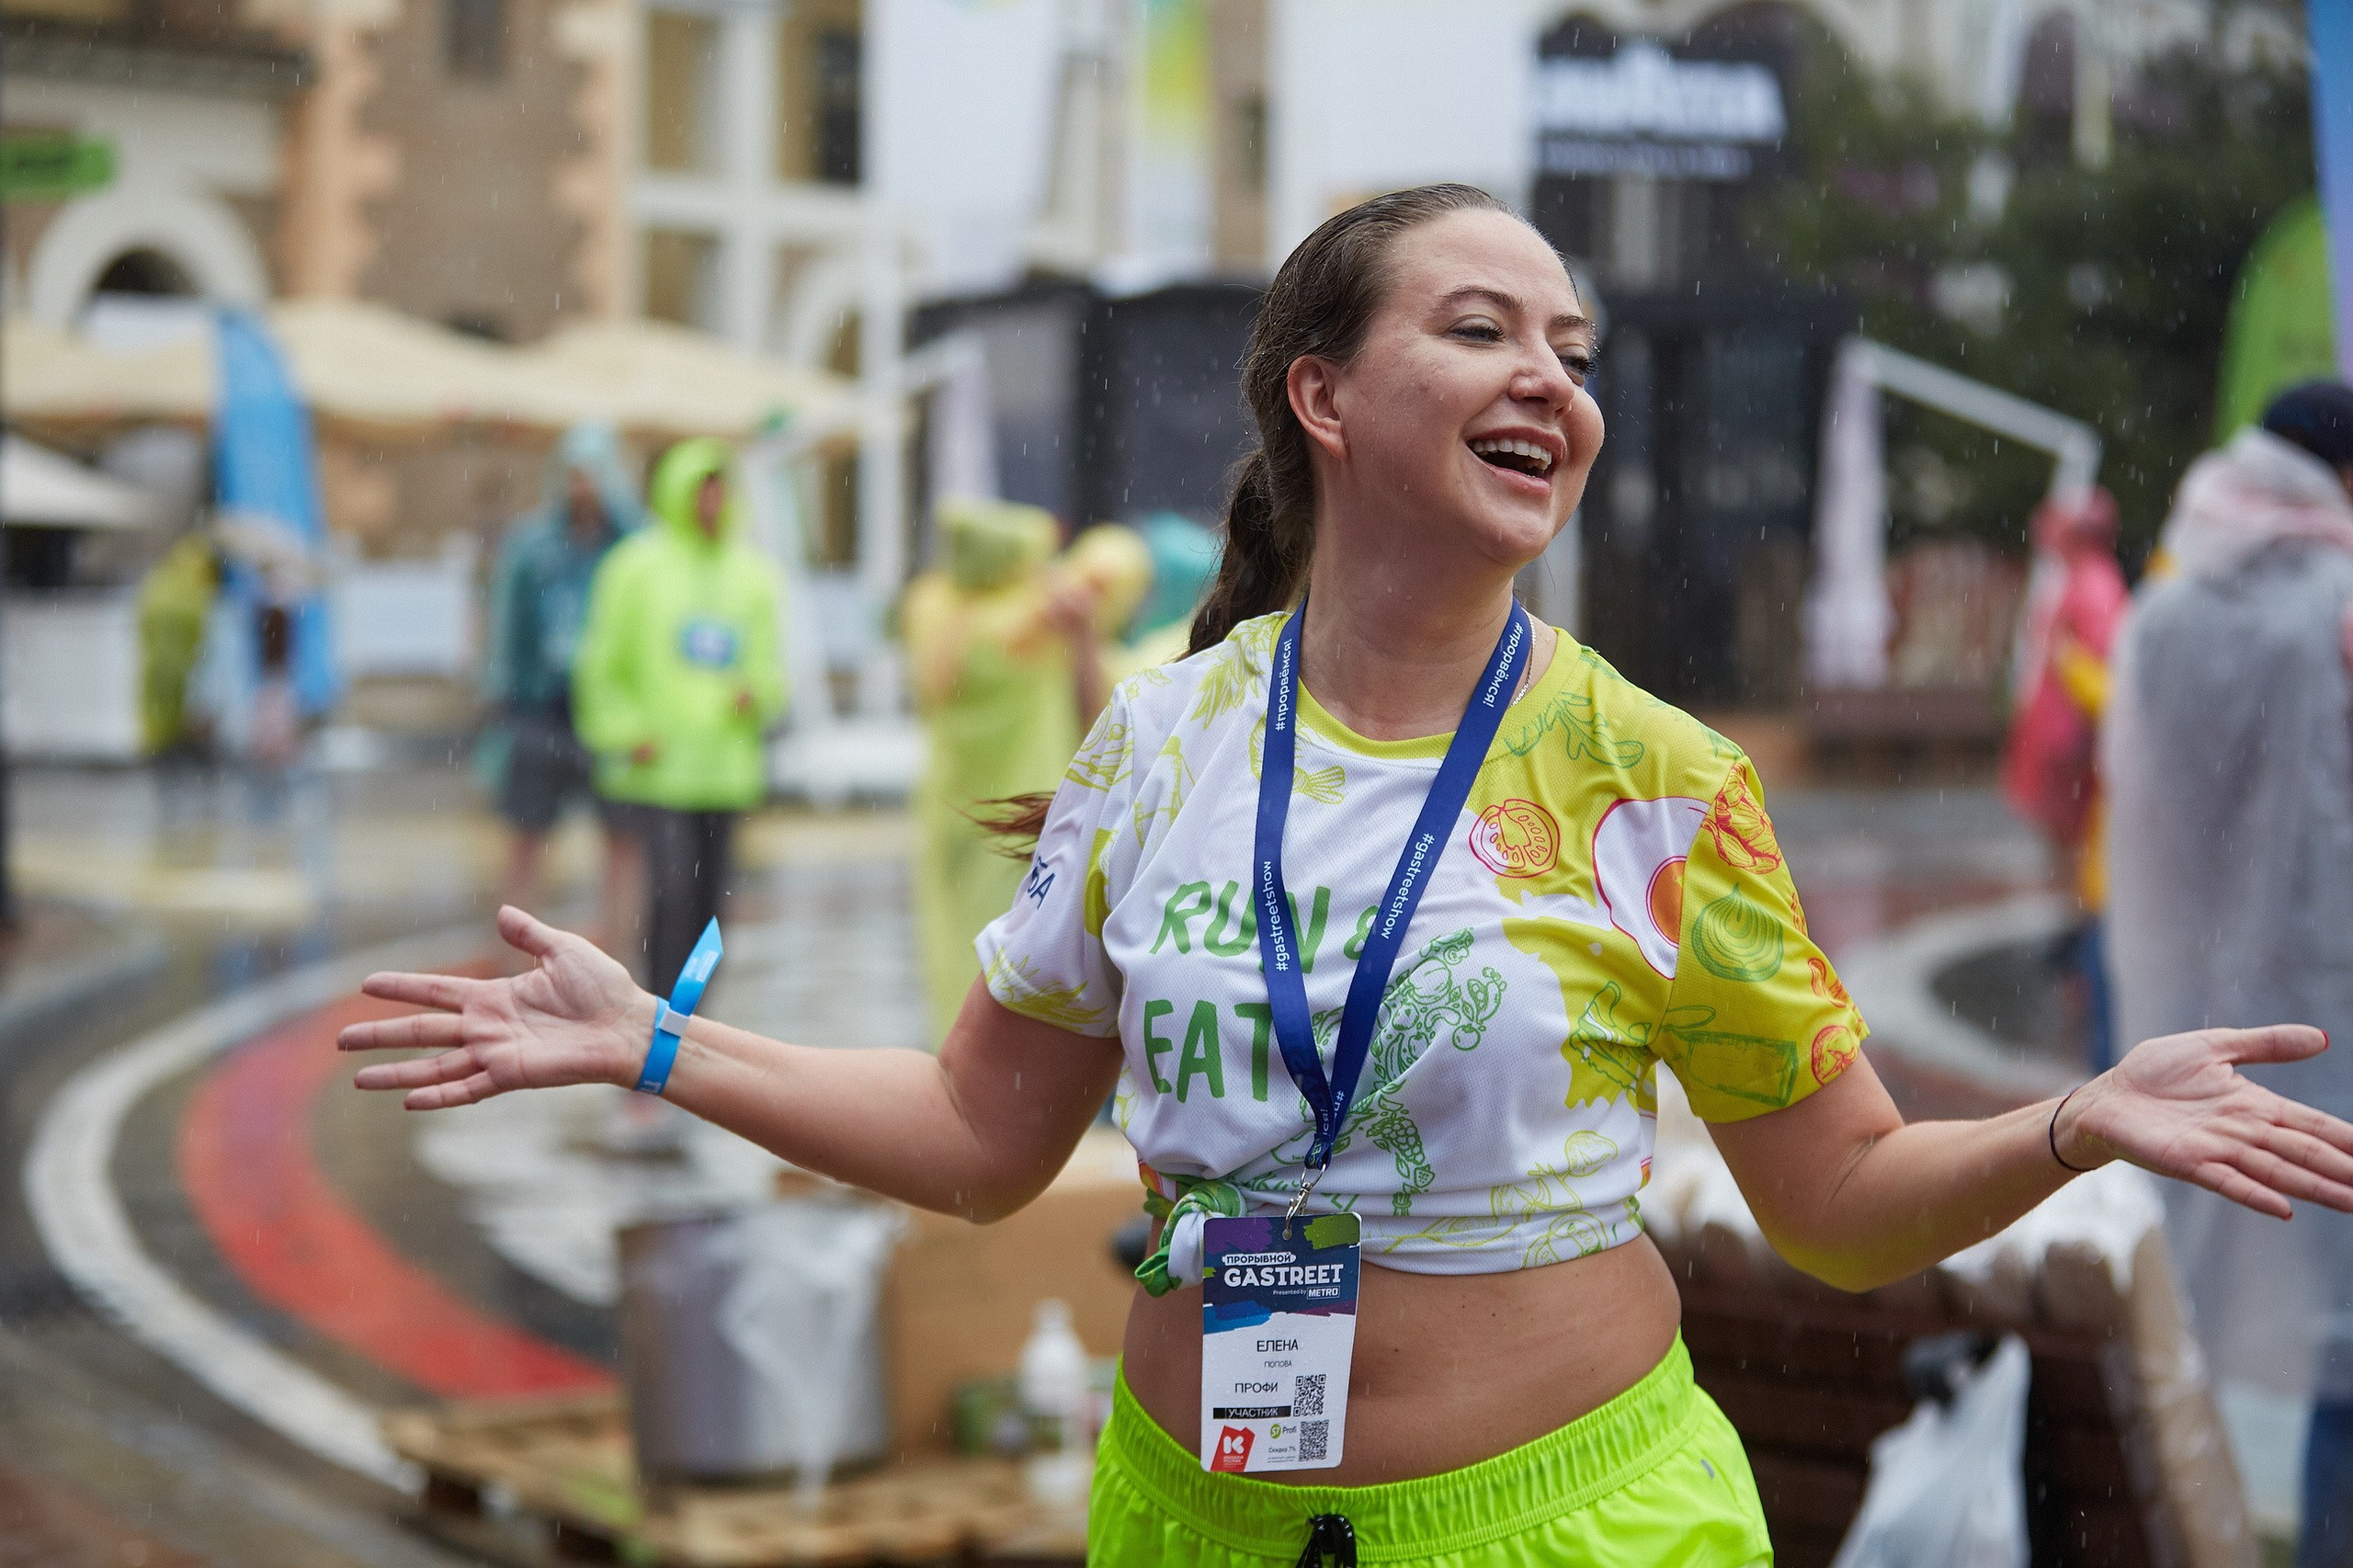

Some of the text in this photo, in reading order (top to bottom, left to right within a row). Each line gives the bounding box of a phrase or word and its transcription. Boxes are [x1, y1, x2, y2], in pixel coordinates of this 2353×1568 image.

[1482, 621, 1524, 709] #прорвёмся!
[1275, 638, 1293, 732] #прорвёмся!
[1381, 833, 1436, 940] #gastreetshow
[1262, 860, 1290, 971] #gastreetshow
[1149, 880, 1331, 974] RUN
[1143, 998, 1273, 1103] EAT
[1226, 1252, 1291, 1265] ПРОРЫВНОЙ
[1223, 1264, 1345, 1288] GASTREET
[1300, 1289, 1307, 1297] by
[1308, 1288, 1339, 1298] METRO
[1256, 1338, 1299, 1353] ЕЛЕНА
[1264, 1359, 1293, 1369] ПОПОВА
[1234, 1381, 1279, 1393] ПРОФИ
[1228, 1407, 1279, 1418] УЧАСТНИК
[1282, 1426, 1297, 1435] Profi
